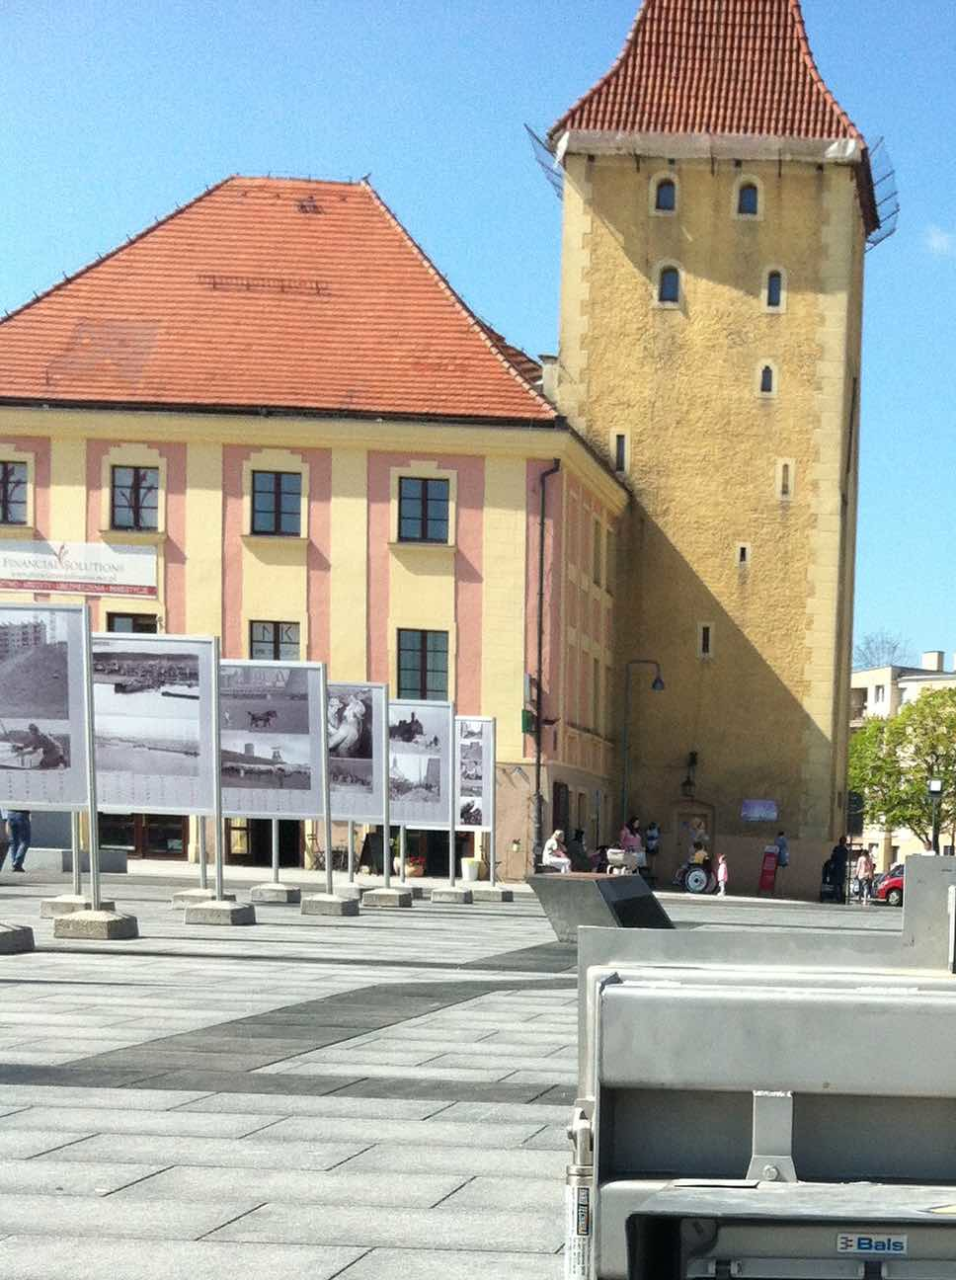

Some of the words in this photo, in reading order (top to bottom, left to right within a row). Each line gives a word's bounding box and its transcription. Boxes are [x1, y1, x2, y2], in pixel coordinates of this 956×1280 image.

[2, 558, 58, 570] FINANCIAL
[65, 561, 125, 573] SOLUTIONS
[857, 1237, 904, 1251] Bals
